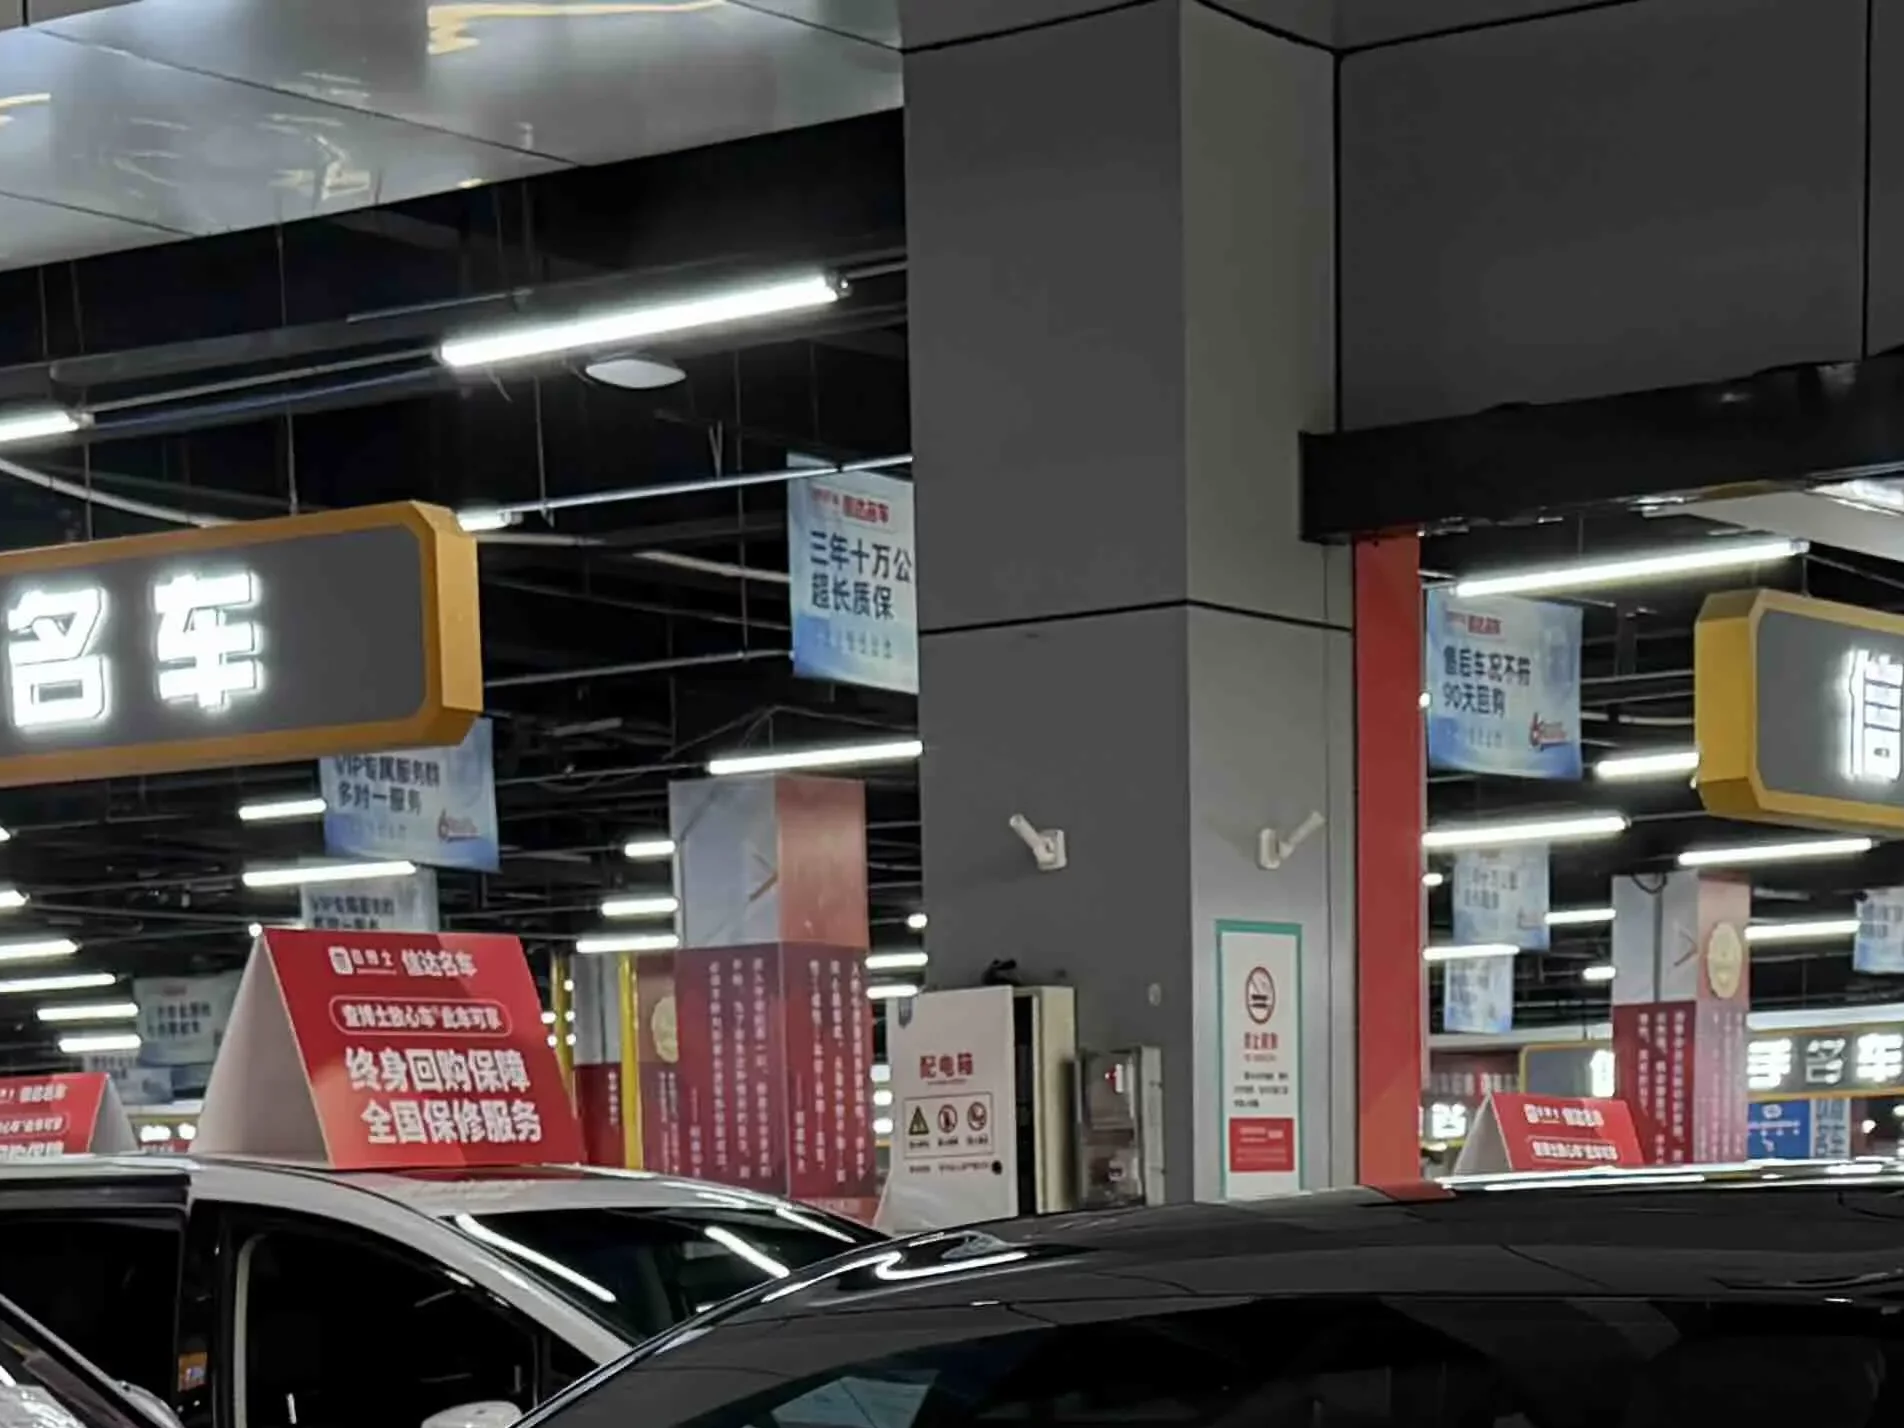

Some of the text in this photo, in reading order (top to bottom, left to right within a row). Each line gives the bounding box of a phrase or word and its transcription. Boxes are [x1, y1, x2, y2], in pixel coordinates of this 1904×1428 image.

[345, 1047, 532, 1093] 终身回购保障
[919, 1053, 975, 1079] 配电箱
[360, 1098, 543, 1144] 全国保修服务
